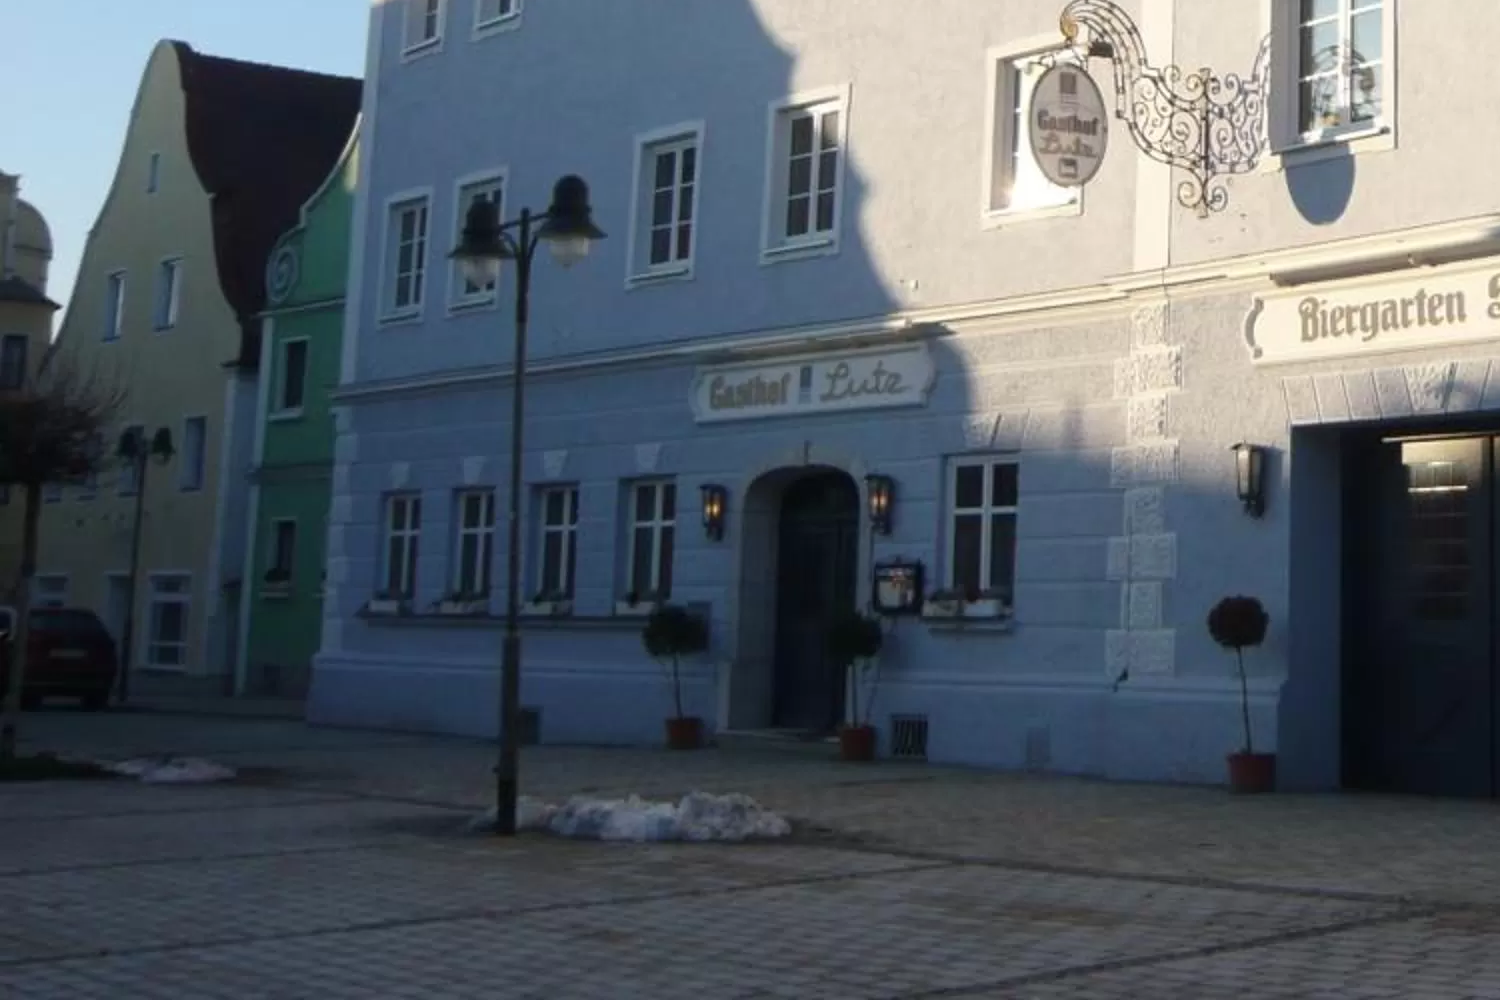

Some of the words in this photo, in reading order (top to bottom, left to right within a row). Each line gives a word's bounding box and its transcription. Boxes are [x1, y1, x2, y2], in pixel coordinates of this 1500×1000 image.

[1298, 288, 1467, 342] Biergarten
[709, 371, 791, 410] Gasthof
[819, 359, 912, 400] Lutz
